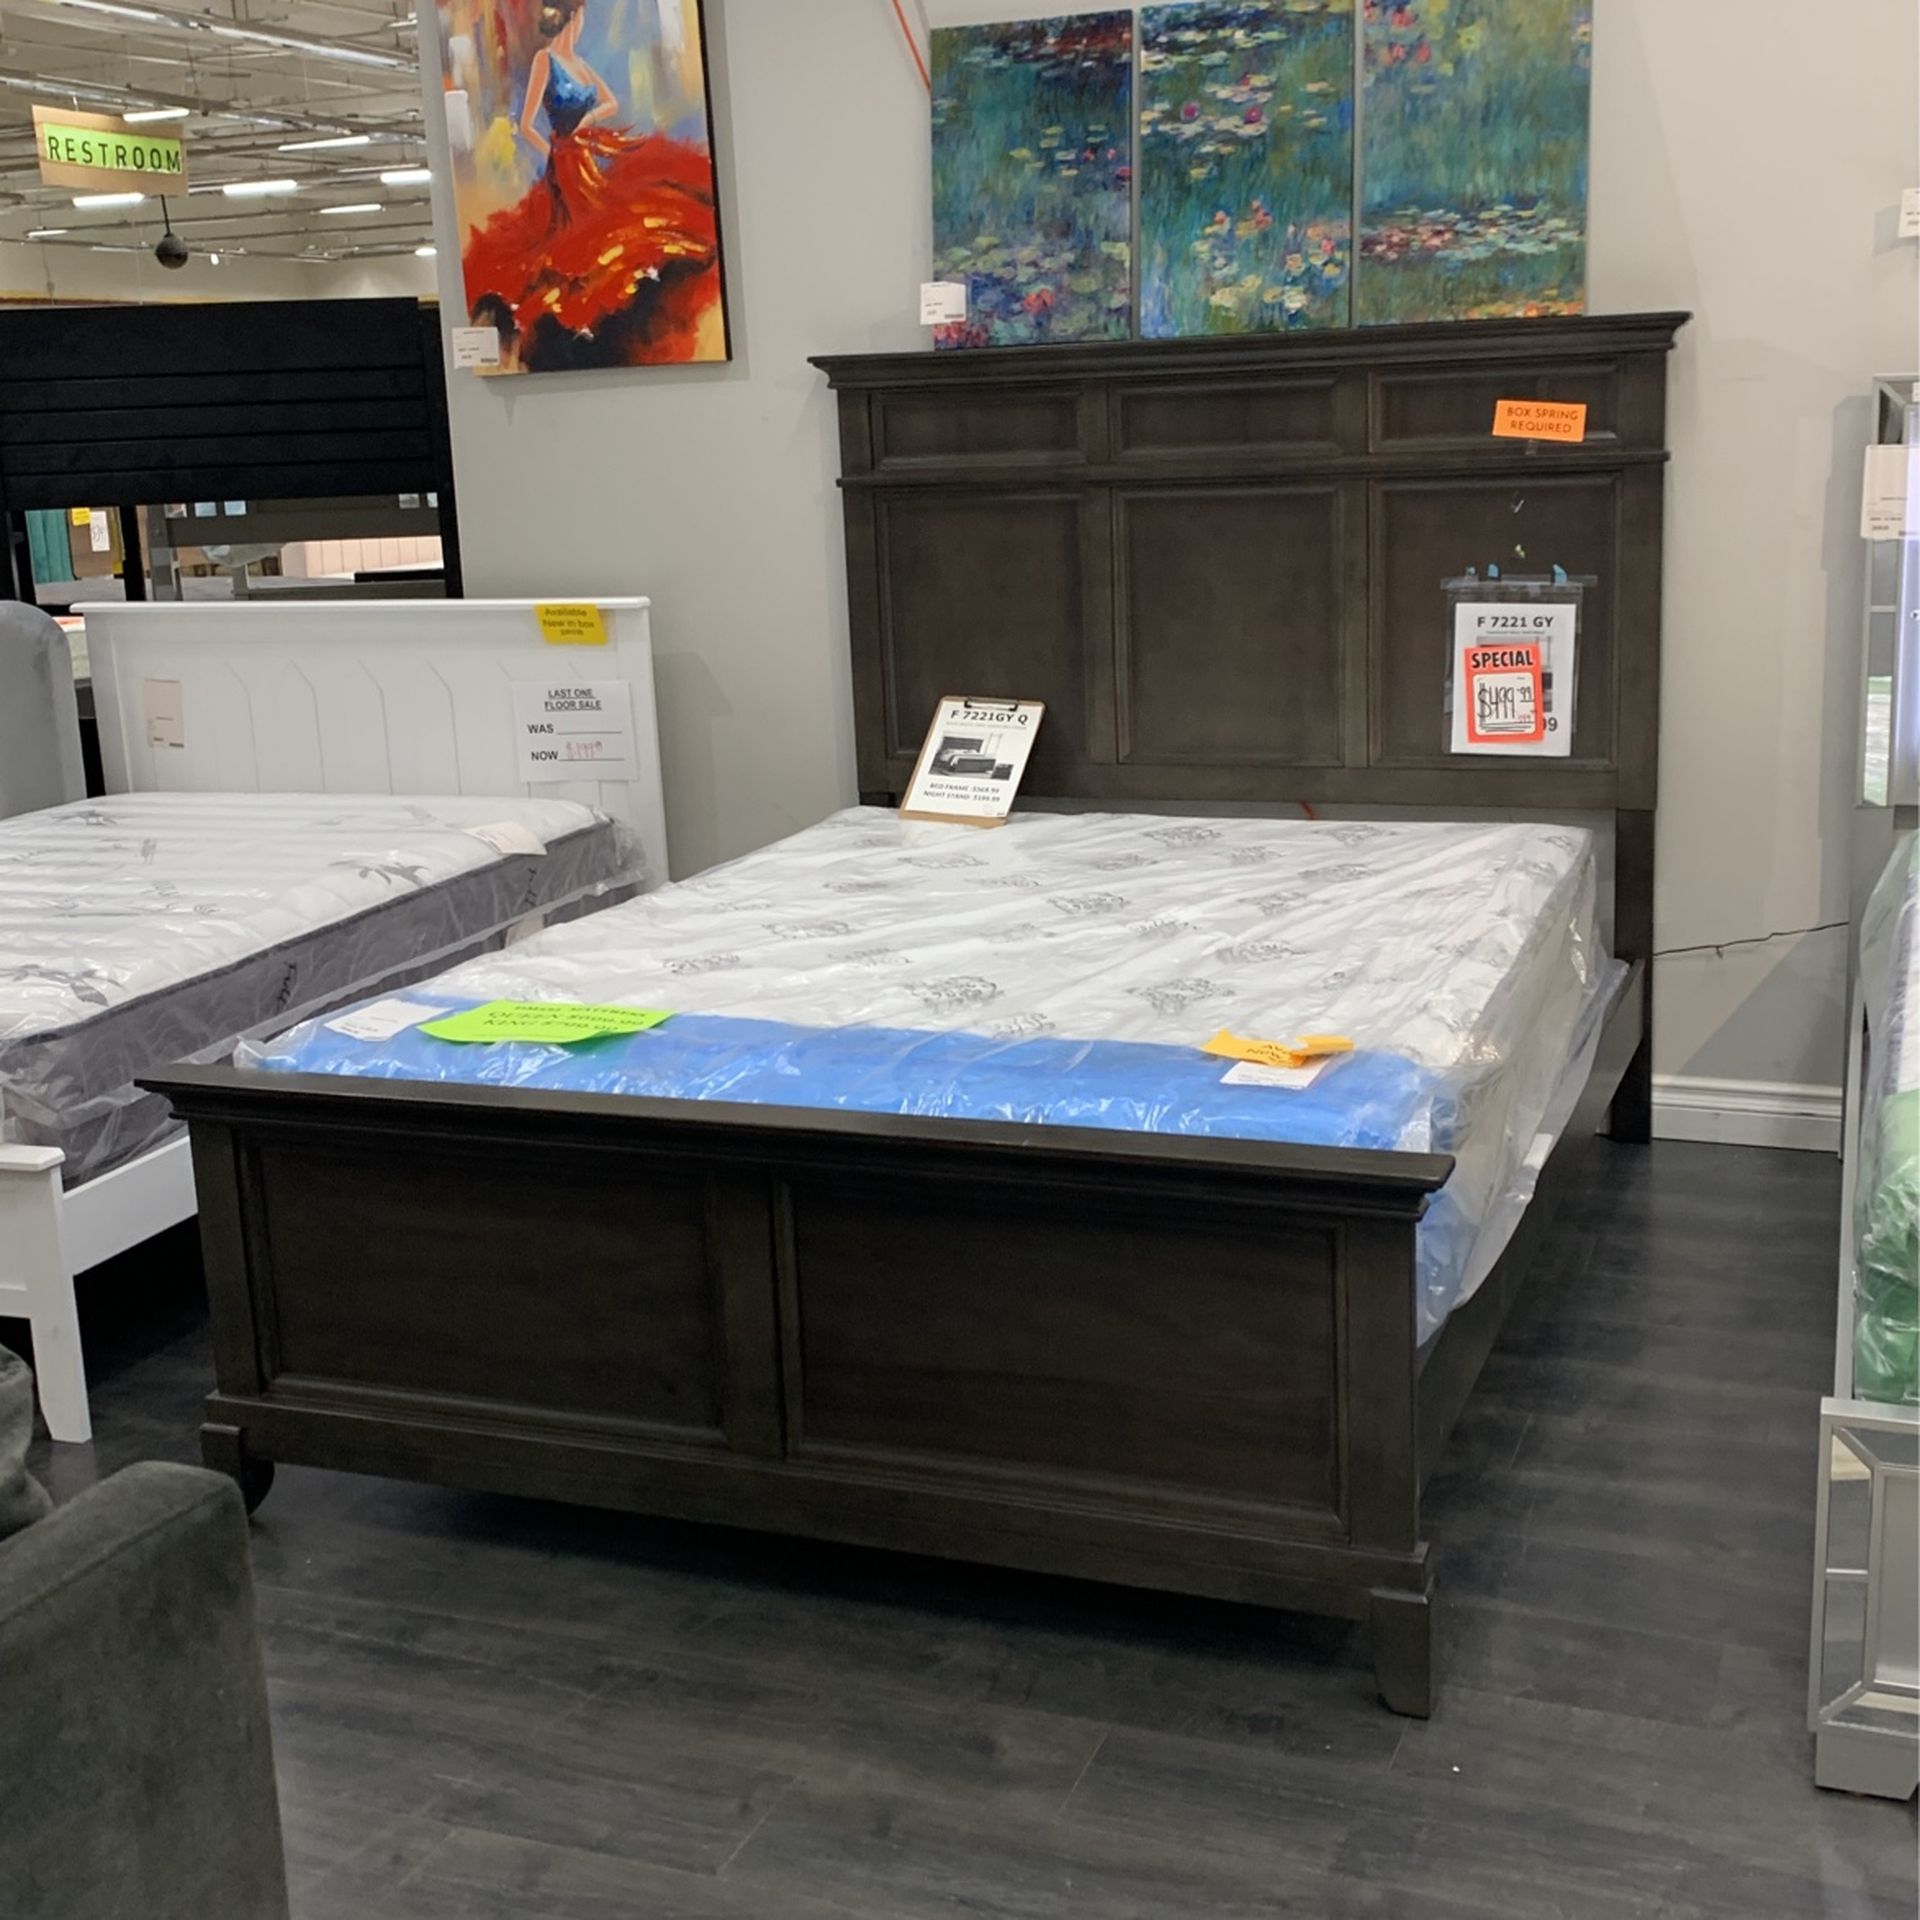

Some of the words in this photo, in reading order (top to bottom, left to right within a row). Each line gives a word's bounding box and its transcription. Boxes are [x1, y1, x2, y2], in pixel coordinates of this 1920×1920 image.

[48, 136, 181, 172] RESTROOM
[1507, 407, 1531, 417] BOX
[1536, 408, 1578, 420] SPRING
[1510, 420, 1572, 433] REQUIRED
[545, 608, 588, 617] Available
[1477, 617, 1486, 627] F
[1491, 617, 1527, 627] 7221
[1533, 617, 1554, 628] GY
[1471, 650, 1534, 668] SPECIAL
[548, 689, 571, 699] LAST
[574, 689, 593, 698] ONE
[545, 700, 576, 711] FLOOR
[578, 700, 602, 710] SALE
[951, 710, 960, 719] F
[963, 710, 1014, 722] 7221GY
[1018, 714, 1029, 724] Q
[527, 723, 554, 734] WAS
[531, 751, 559, 761] NOW
